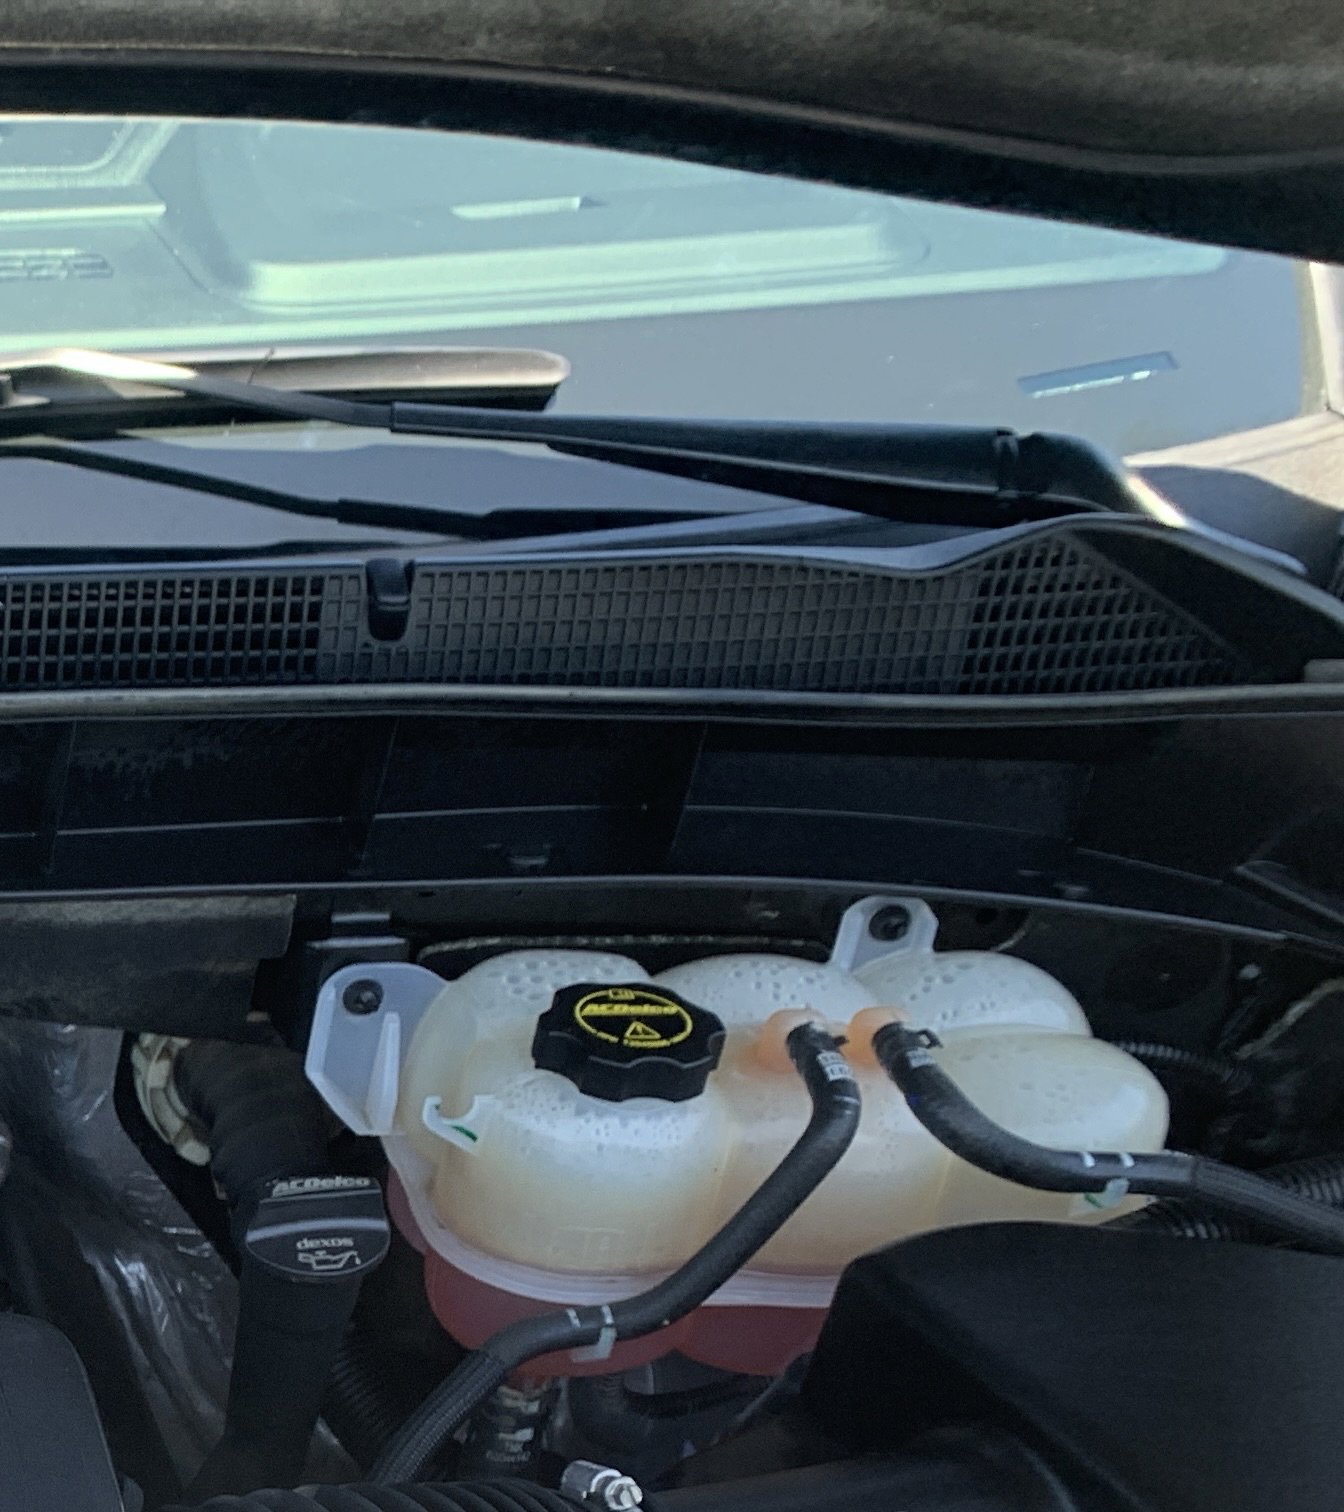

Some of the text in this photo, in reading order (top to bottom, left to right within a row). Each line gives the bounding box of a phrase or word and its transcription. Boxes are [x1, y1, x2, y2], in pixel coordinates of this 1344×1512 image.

[580, 1003, 680, 1018] ACDelco
[271, 1175, 371, 1198] ACDelco
[296, 1237, 354, 1250] dexos
